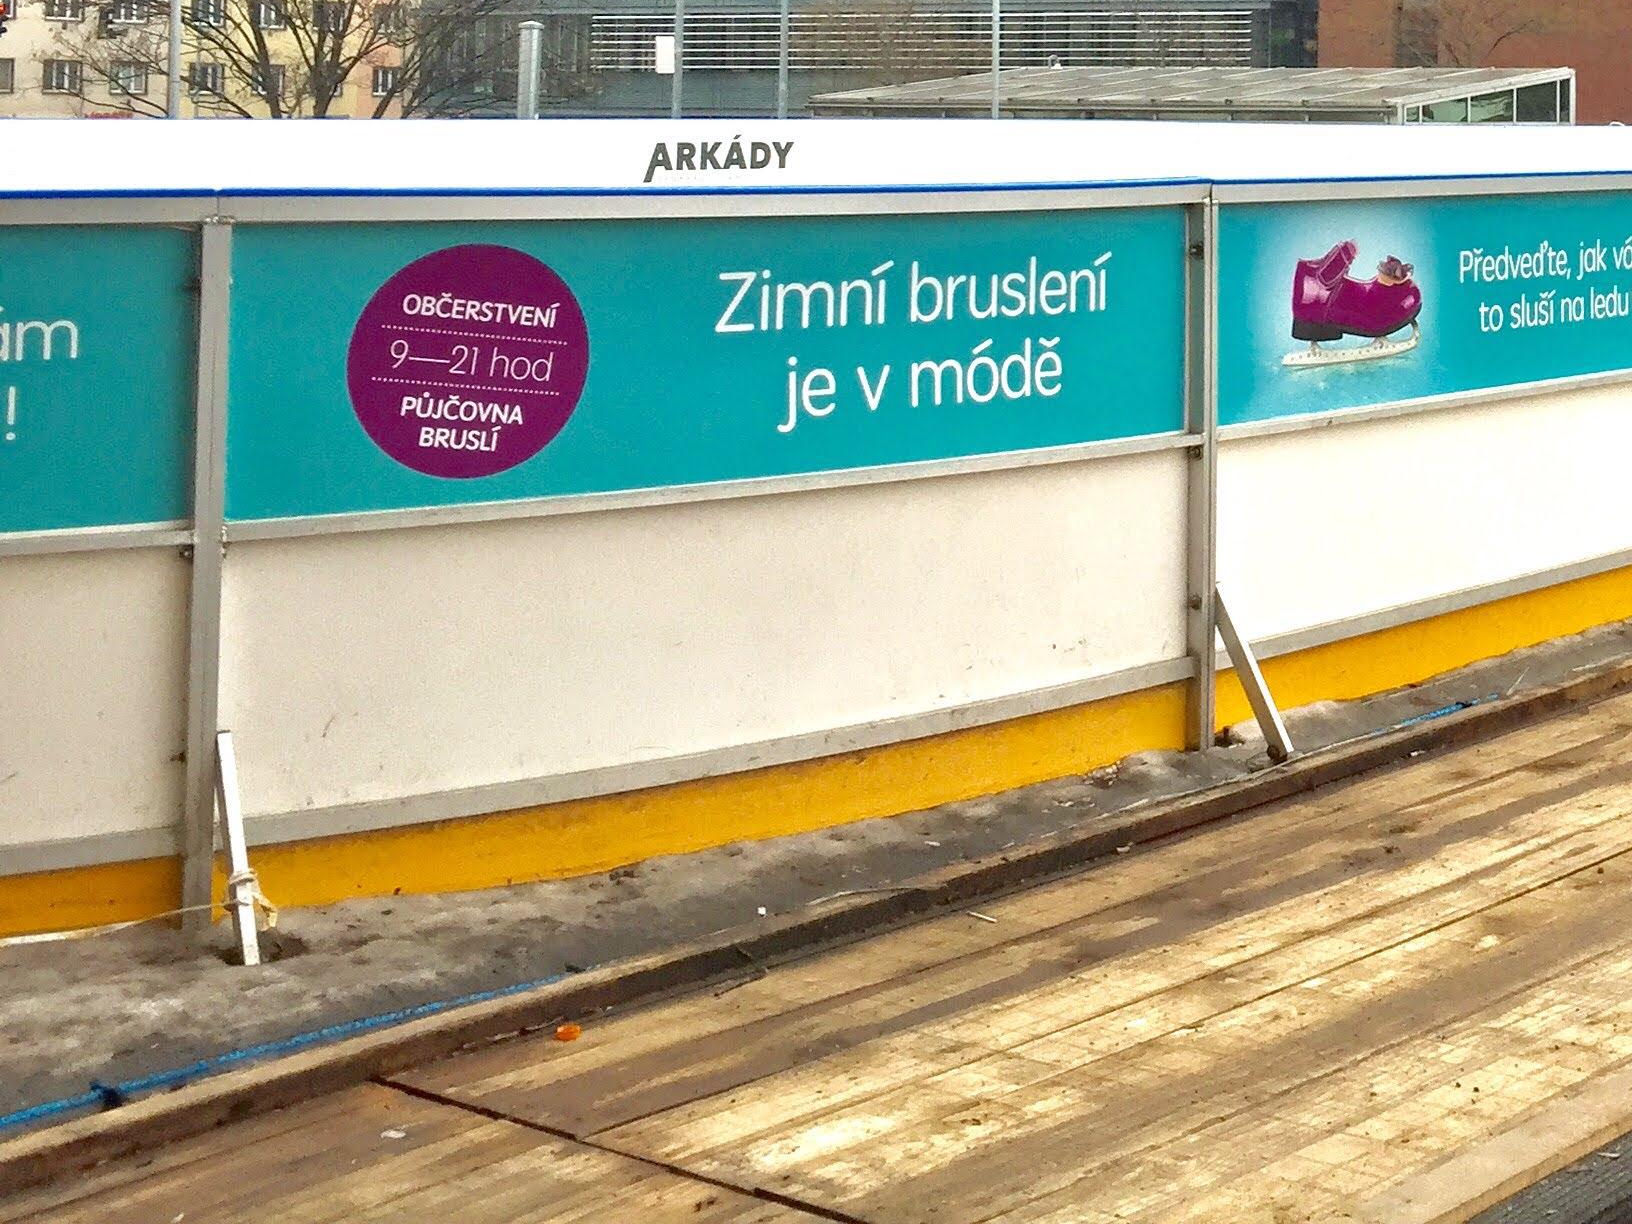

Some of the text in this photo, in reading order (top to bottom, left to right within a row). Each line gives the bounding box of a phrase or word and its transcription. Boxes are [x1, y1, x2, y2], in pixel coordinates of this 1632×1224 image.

[643, 134, 795, 183] ARKÁDY
[1459, 240, 1572, 284] Předveďte,
[1577, 238, 1608, 281] jak
[402, 292, 560, 328] OBČERSTVENÍ
[715, 251, 1112, 333] Zimní bruslení
[1479, 301, 1504, 332] to
[1510, 289, 1556, 329] sluší
[1560, 296, 1585, 323] na
[489, 347, 554, 382] hod
[777, 336, 1063, 433] je v módě
[400, 391, 524, 425] PŮJČOVNA
[418, 426, 502, 452] BRUSLÍ
